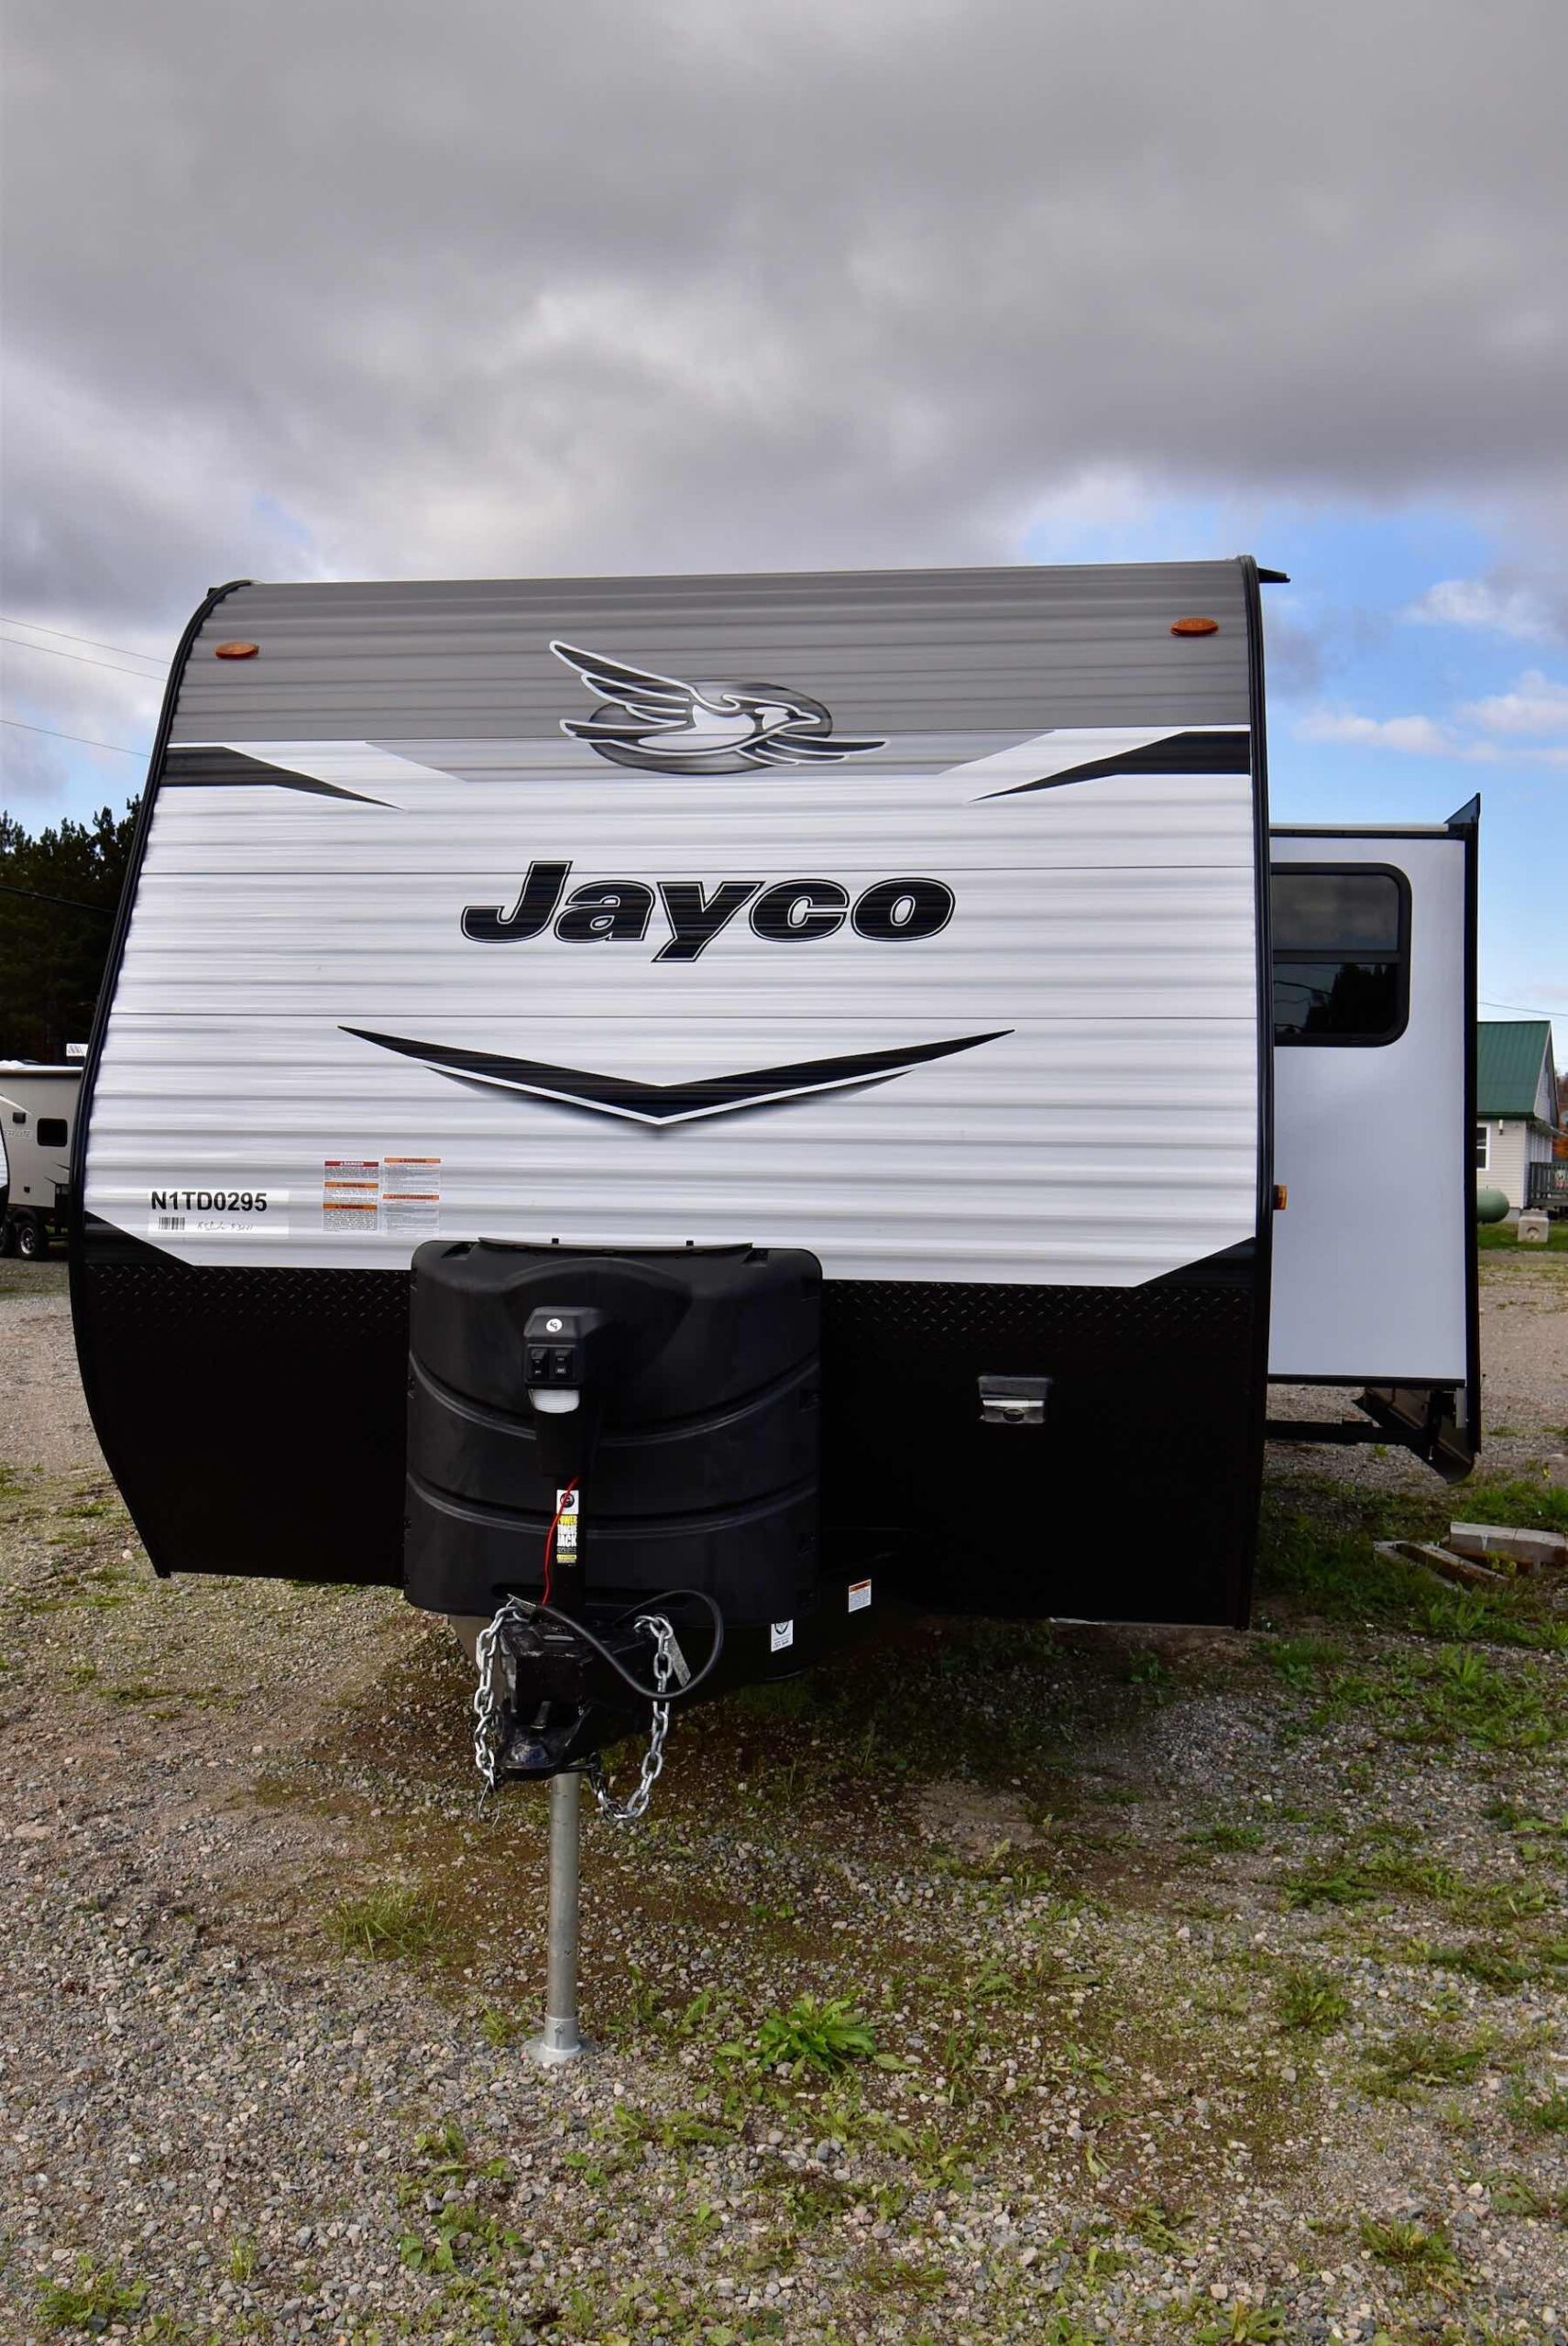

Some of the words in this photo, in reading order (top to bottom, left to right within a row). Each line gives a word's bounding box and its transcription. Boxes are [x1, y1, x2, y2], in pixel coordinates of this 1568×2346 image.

[460, 860, 957, 962] Jayco
[151, 1190, 268, 1212] N1TD0295
[556, 1534, 577, 1547] JACK
